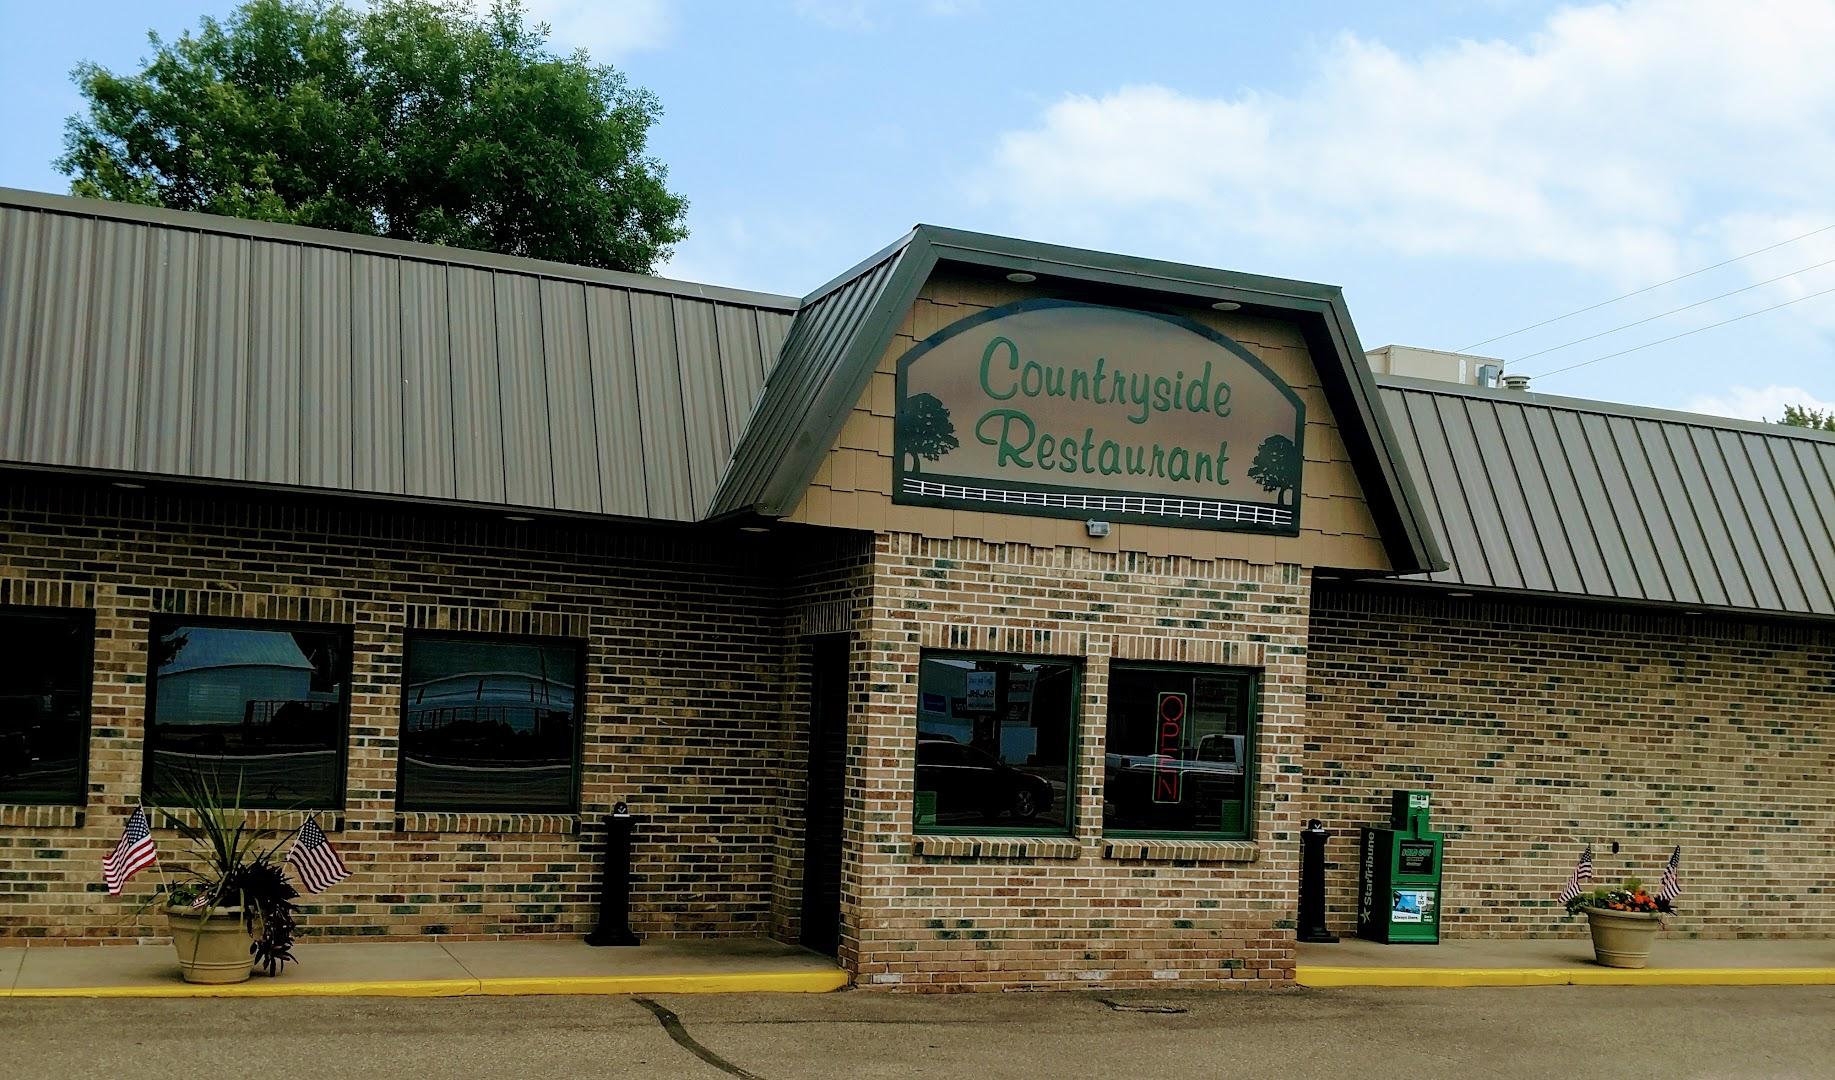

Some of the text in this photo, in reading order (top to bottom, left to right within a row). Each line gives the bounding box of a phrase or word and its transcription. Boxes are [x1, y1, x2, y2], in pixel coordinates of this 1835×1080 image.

[979, 336, 1232, 424] Countryside
[975, 409, 1231, 486] Restaurant
[1157, 695, 1184, 800] OPEN
